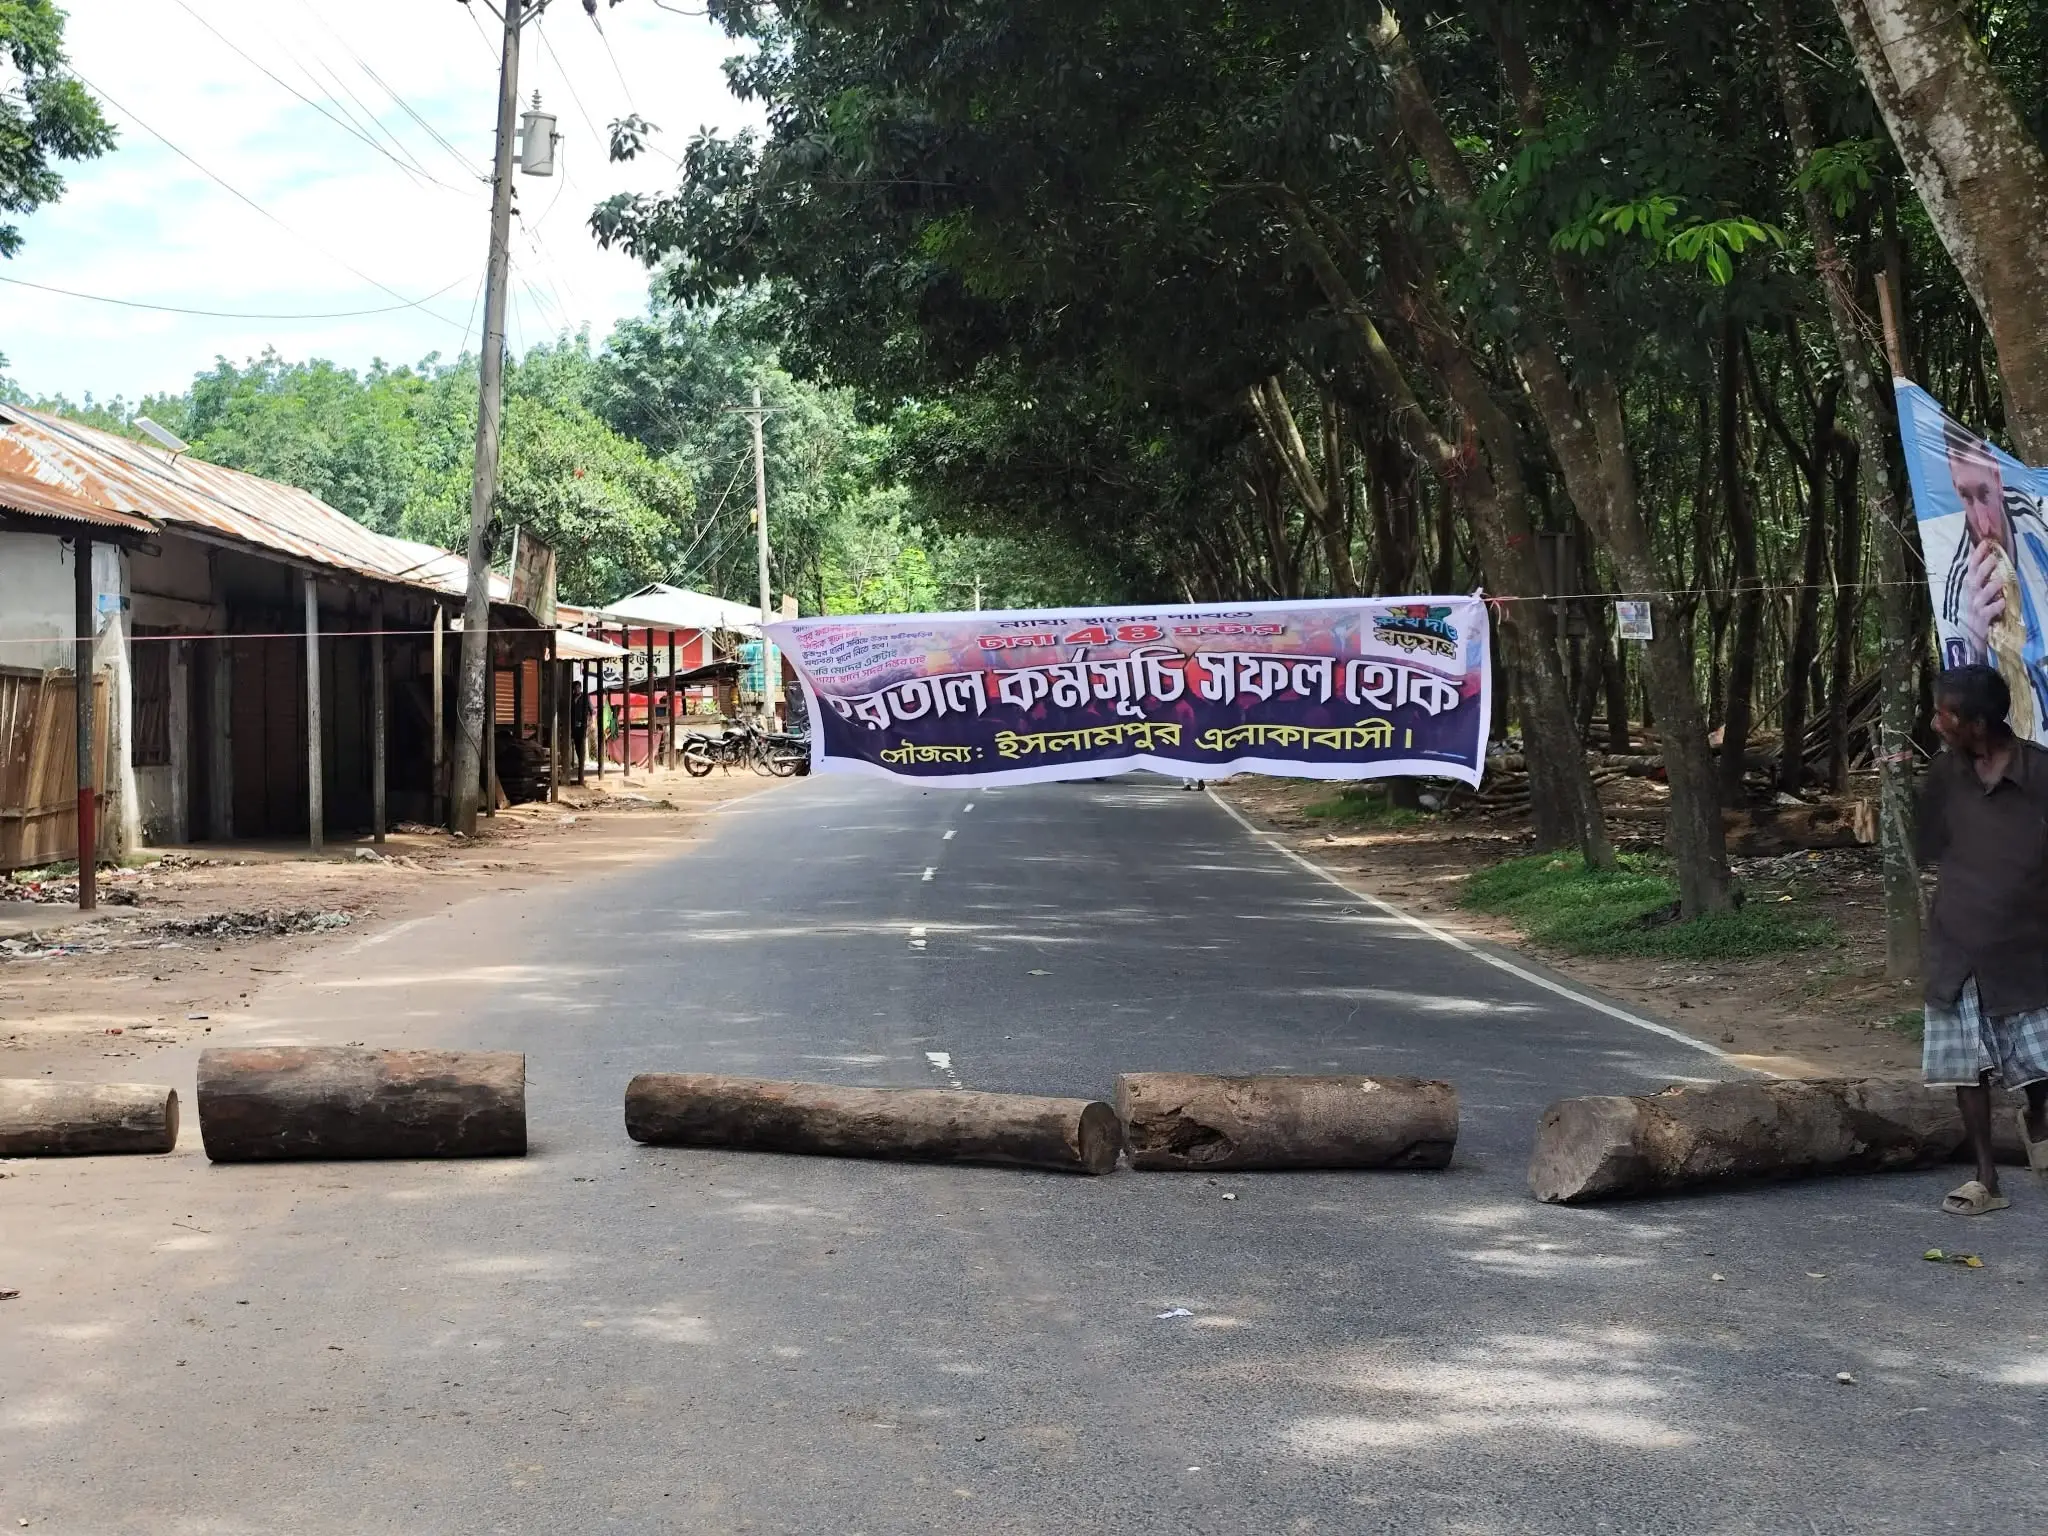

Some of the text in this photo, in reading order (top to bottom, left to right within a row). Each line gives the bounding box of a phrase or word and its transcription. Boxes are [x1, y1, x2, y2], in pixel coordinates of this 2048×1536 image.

[975, 633, 1056, 650] টানা
[1063, 624, 1165, 647] 48
[995, 645, 1186, 721] কর্মসূচি
[1195, 650, 1337, 707] সফল
[1346, 658, 1464, 718] হোক
[995, 722, 1183, 761] ইসলামপুর
